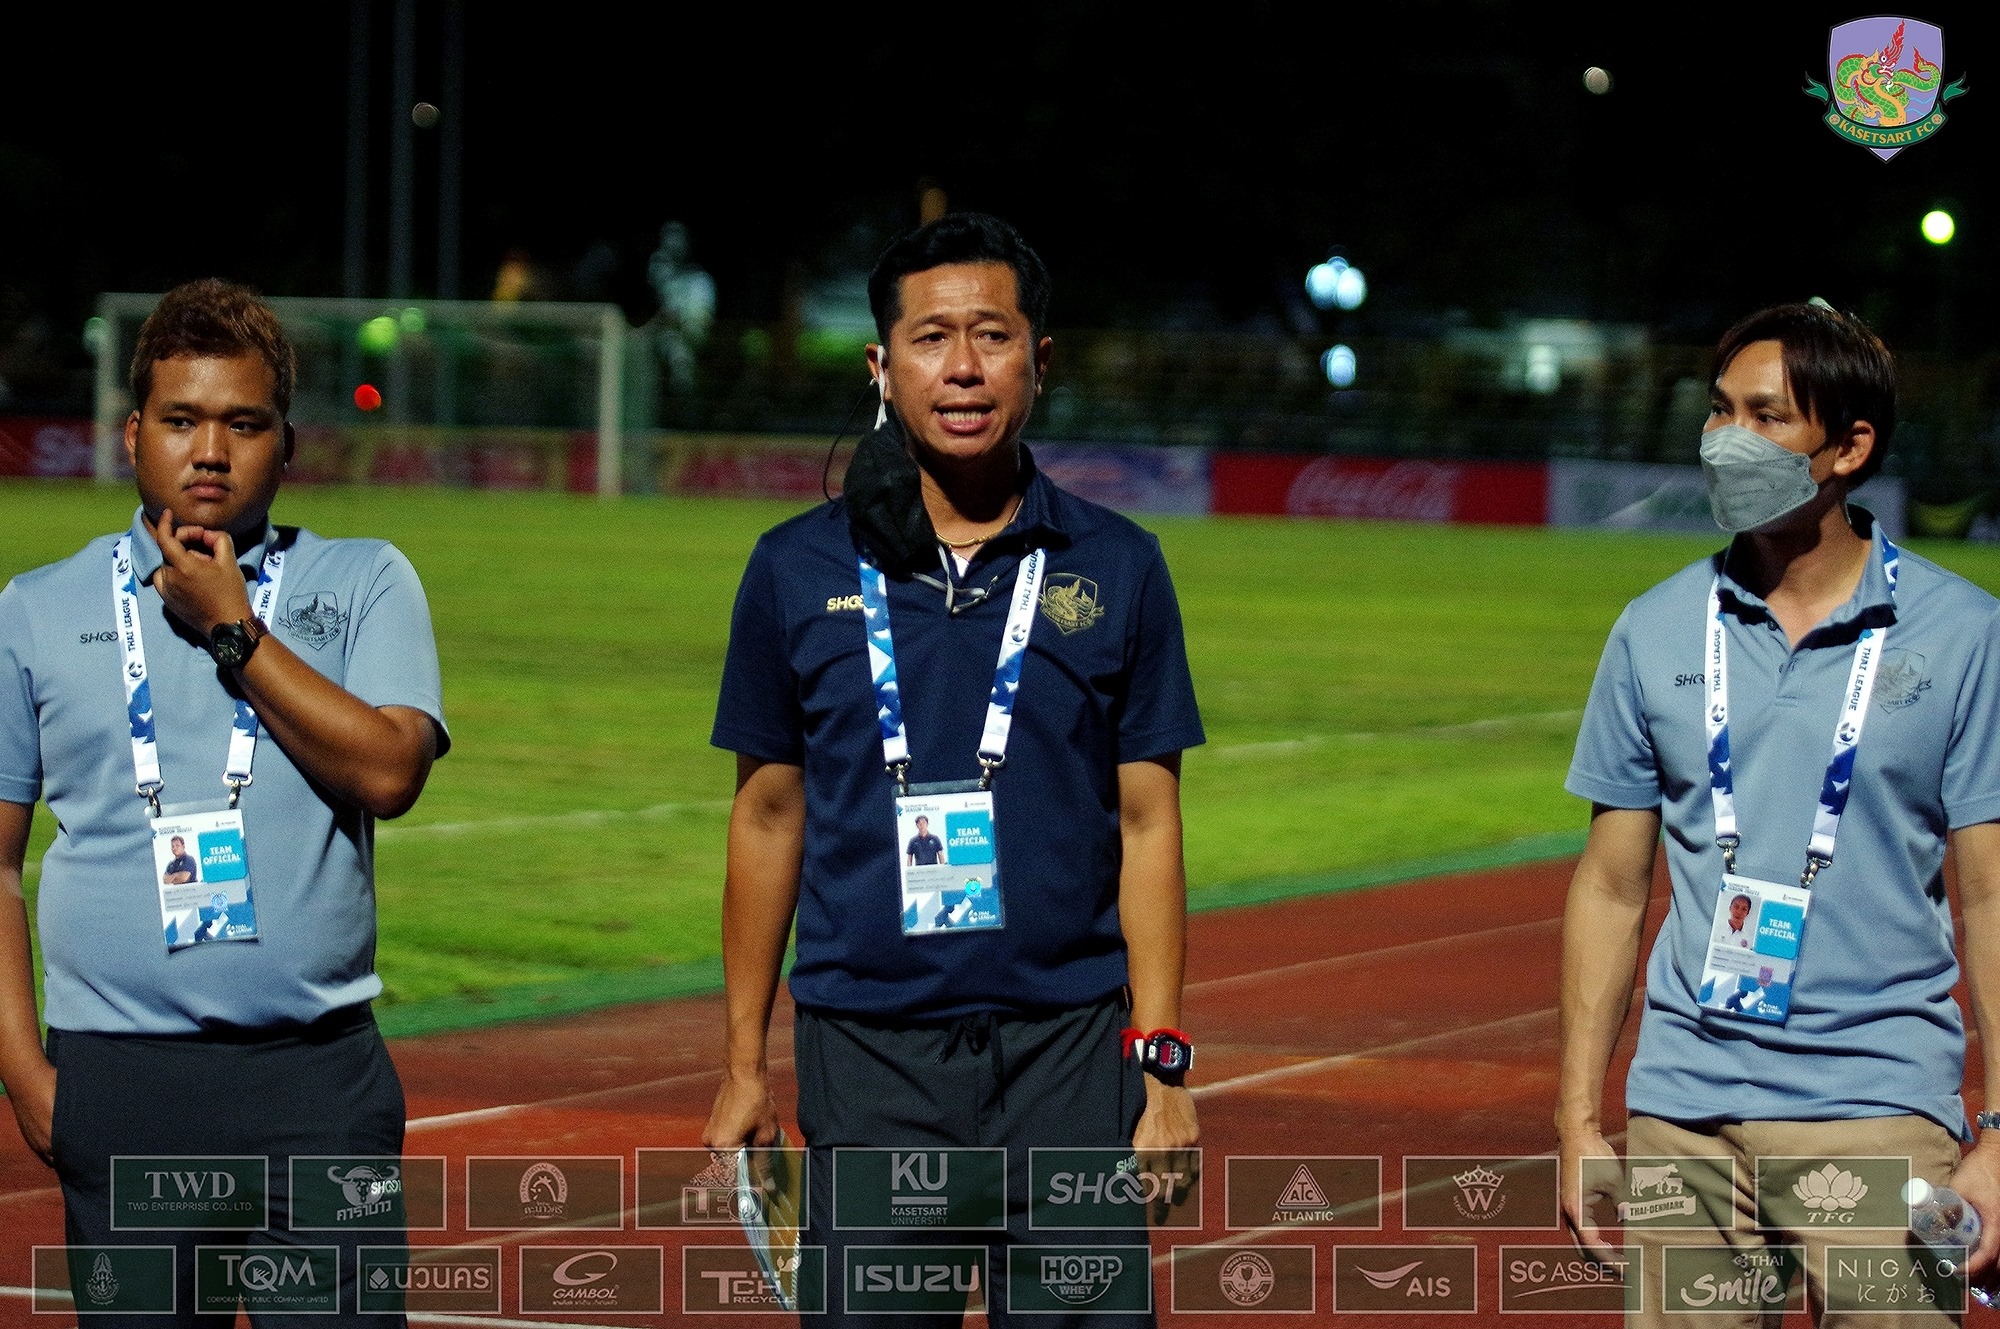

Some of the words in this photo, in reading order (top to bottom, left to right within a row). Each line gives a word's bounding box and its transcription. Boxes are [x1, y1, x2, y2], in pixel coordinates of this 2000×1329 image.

[1020, 589, 1031, 611] THAI
[1026, 551, 1039, 586] LEAGUE
[826, 594, 865, 613] SHO
[122, 597, 133, 628] LEAGUE
[79, 631, 119, 644] SHOO
[126, 631, 136, 652] THAI
[1713, 629, 1721, 664] LEAGUE
[1859, 647, 1871, 671] THAI
[1674, 673, 1706, 687] SHO
[1713, 668, 1721, 692] THAI
[1848, 674, 1865, 711] LEAGUE
[957, 827, 980, 836] TEAM
[949, 836, 989, 846] OFFICIAL
[209, 845, 232, 855] TEAM
[203, 853, 241, 865] OFFICIAL
[1769, 918, 1791, 930] TEAM
[1759, 926, 1797, 941] OFFICIAL
